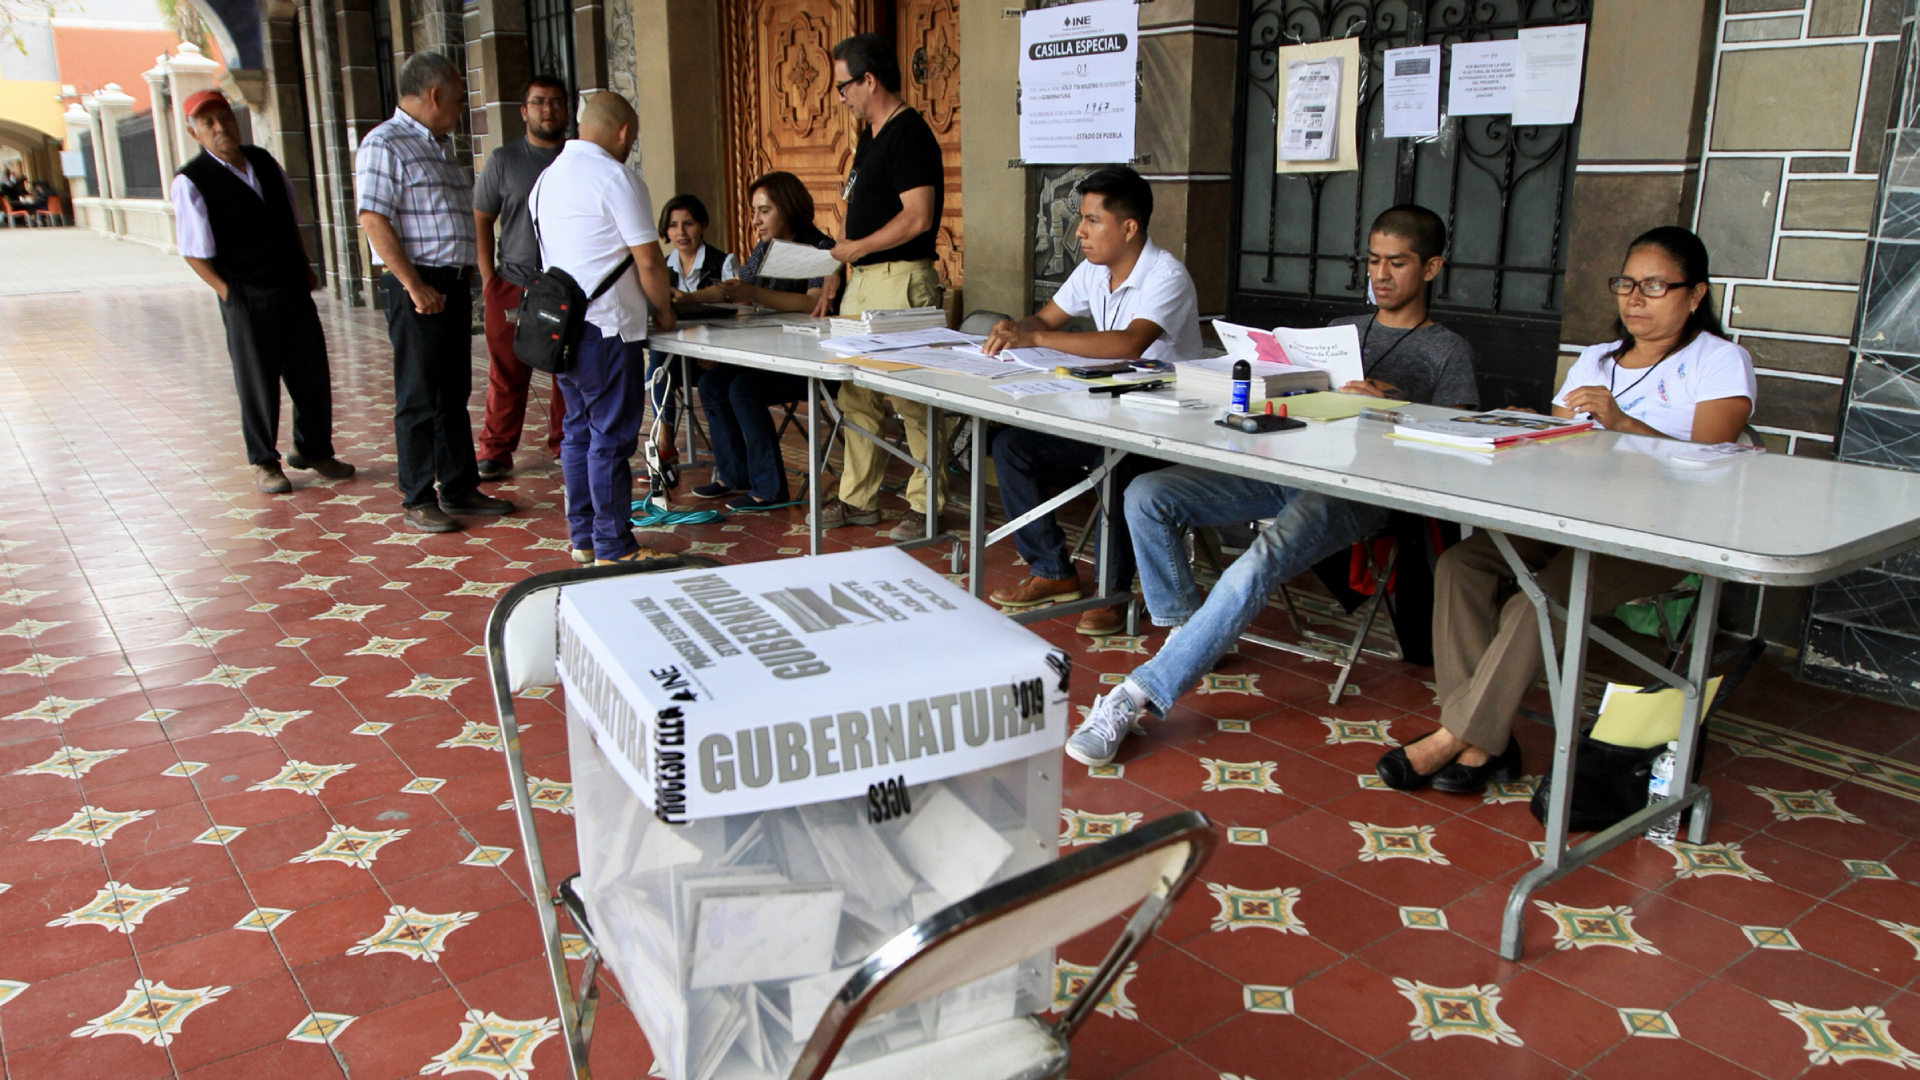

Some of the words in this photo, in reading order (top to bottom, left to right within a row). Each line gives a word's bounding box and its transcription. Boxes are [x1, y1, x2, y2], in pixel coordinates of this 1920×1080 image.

[1072, 15, 1091, 26] INE
[1035, 42, 1073, 58] CASILLA
[1076, 36, 1120, 53] ESPECIAL
[1077, 132, 1095, 140] ESTADO
[841, 580, 909, 621] DEPOSITE
[901, 578, 959, 611] BOLETA
[672, 573, 831, 680] GUBERNATURA
[649, 665, 690, 691] INE
[560, 616, 650, 782] GUBERNATURA
[698, 683, 1045, 793] GUBERNATURA
